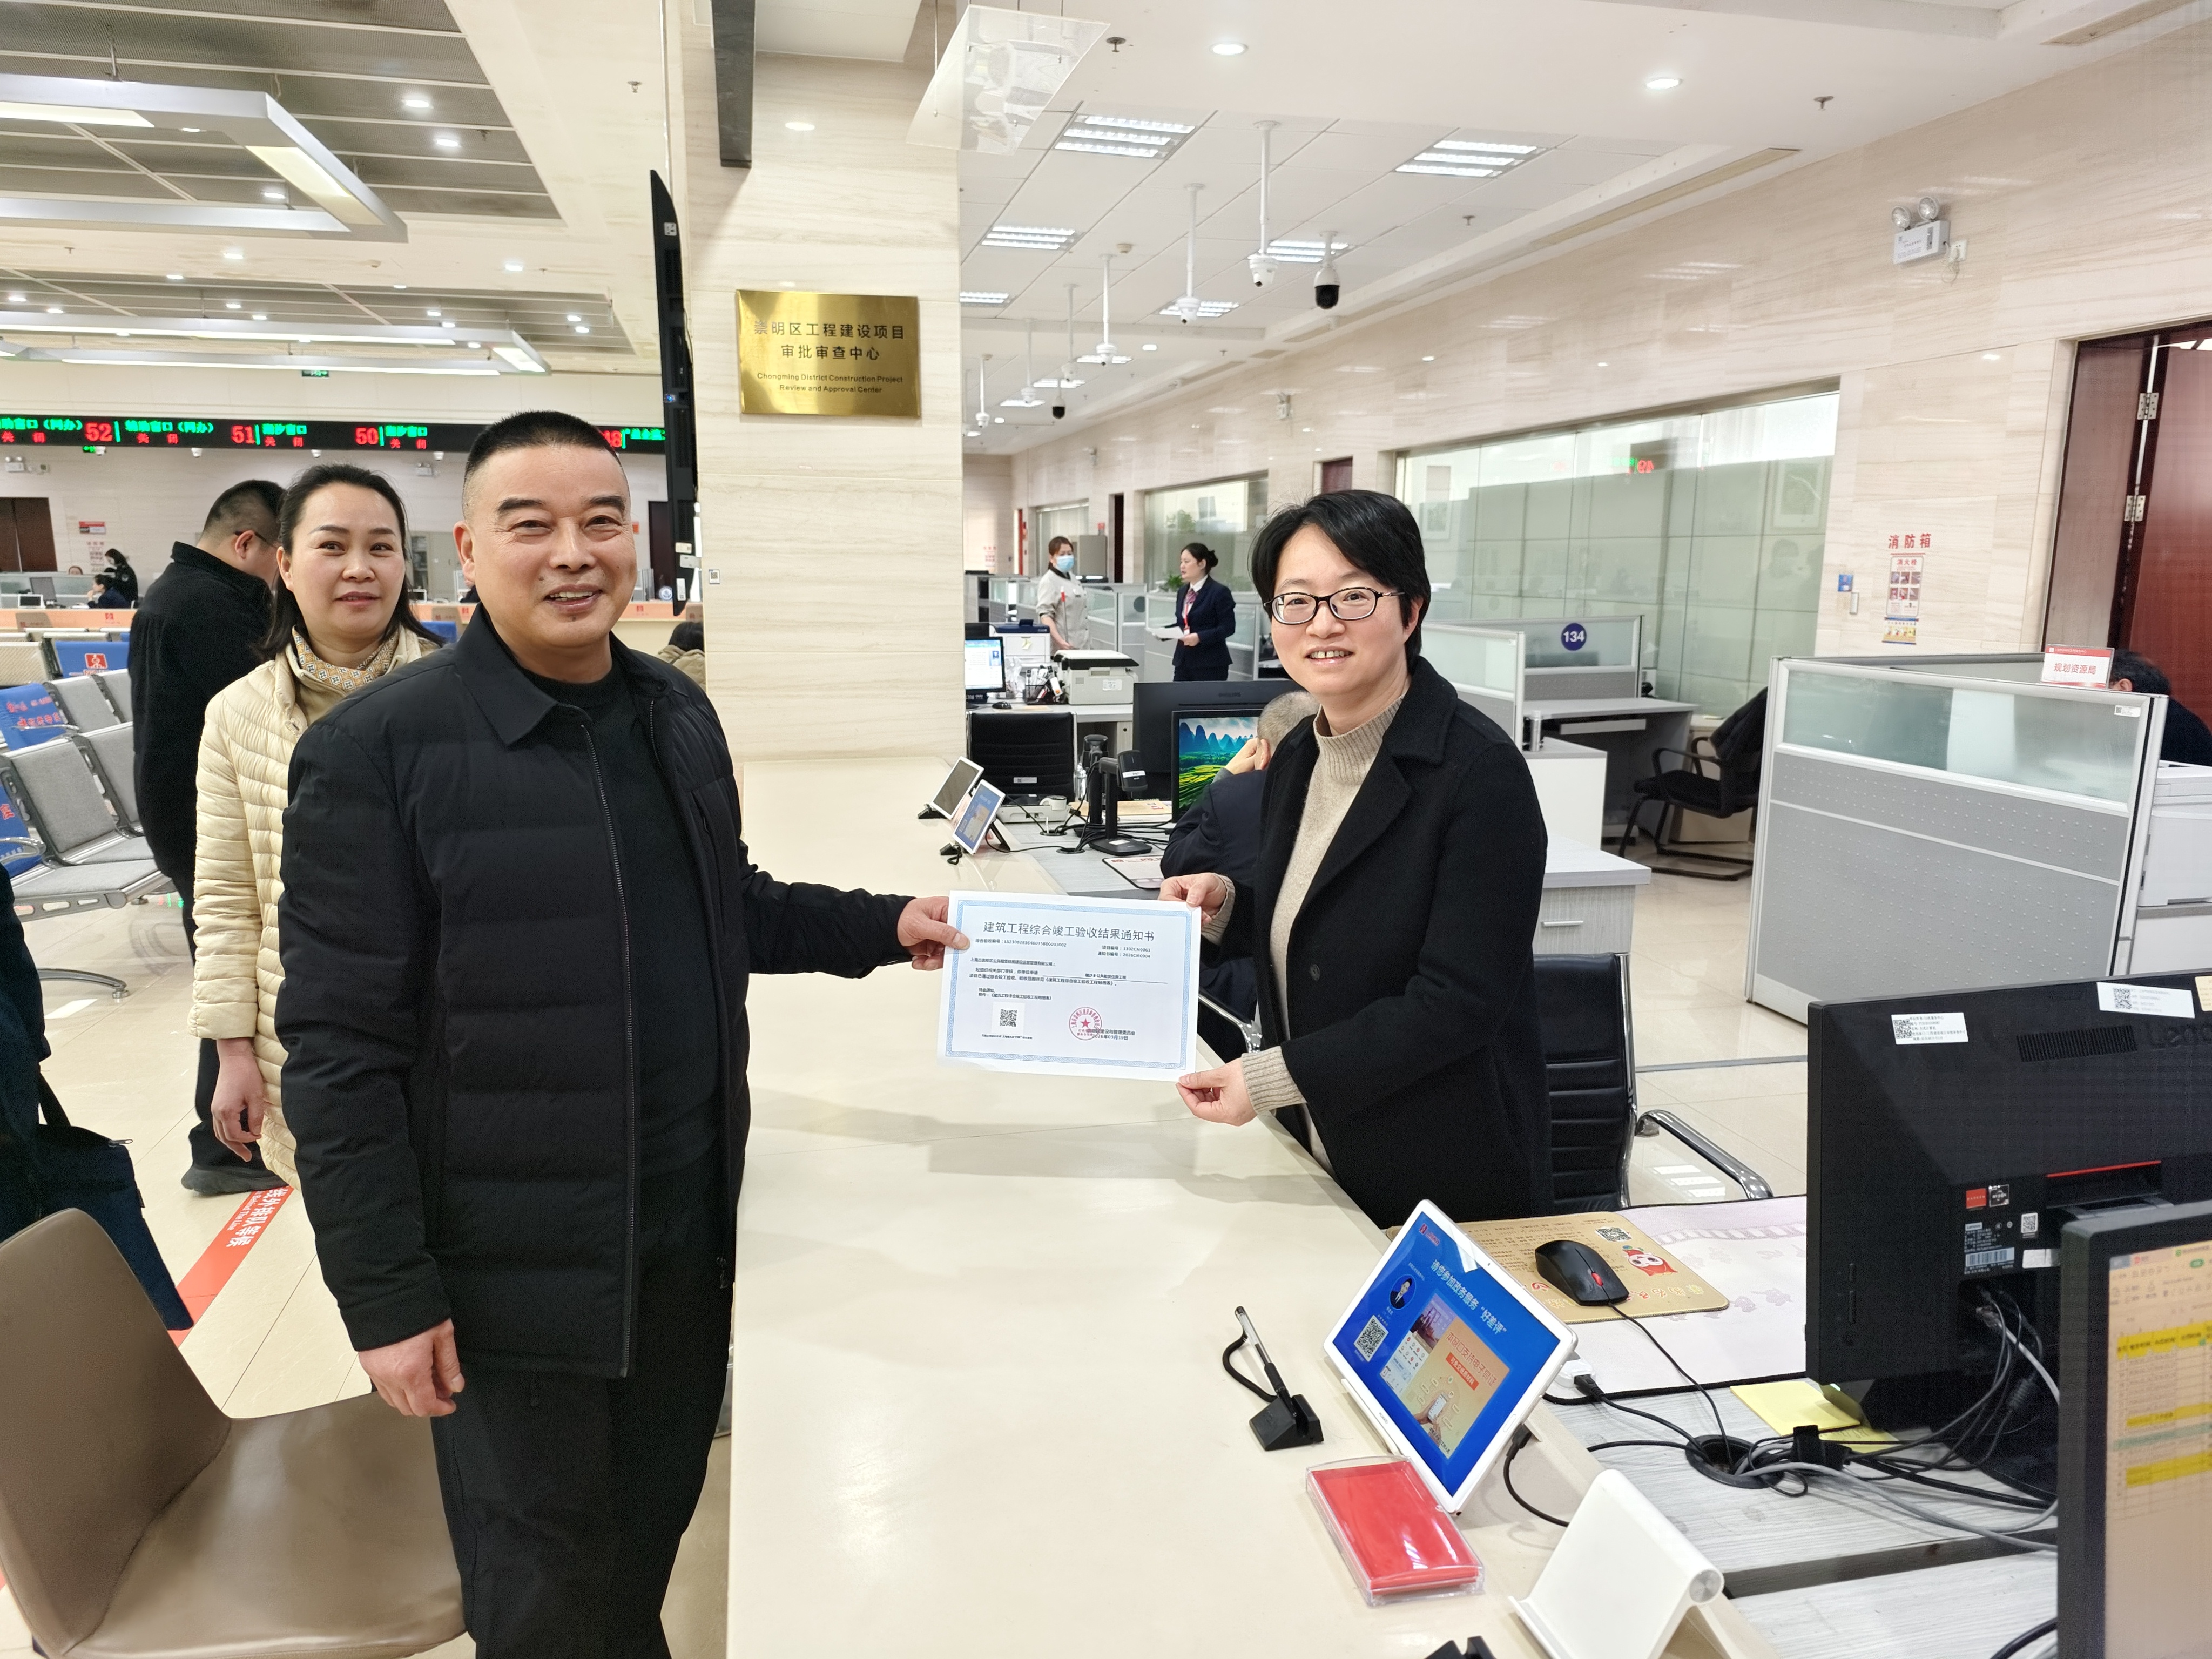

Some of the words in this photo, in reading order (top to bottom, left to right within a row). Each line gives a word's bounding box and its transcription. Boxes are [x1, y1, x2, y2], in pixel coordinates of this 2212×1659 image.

[754, 320, 904, 339] 崇明区工程建设项目
[781, 345, 880, 361] 审批审查中心
[757, 373, 799, 381] Chongming
[801, 373, 827, 381] District
[824, 385, 857, 394] Approval
[85, 422, 113, 442] 52
[231, 425, 255, 444] 51
[355, 427, 379, 445] 50
[1888, 532, 1932, 549] 消防箱
[1563, 630, 1585, 643] 134
[2053, 663, 2096, 675] 规划资源局
[983, 921, 1155, 942] 建筑工程综合竣工验收结果通知书
